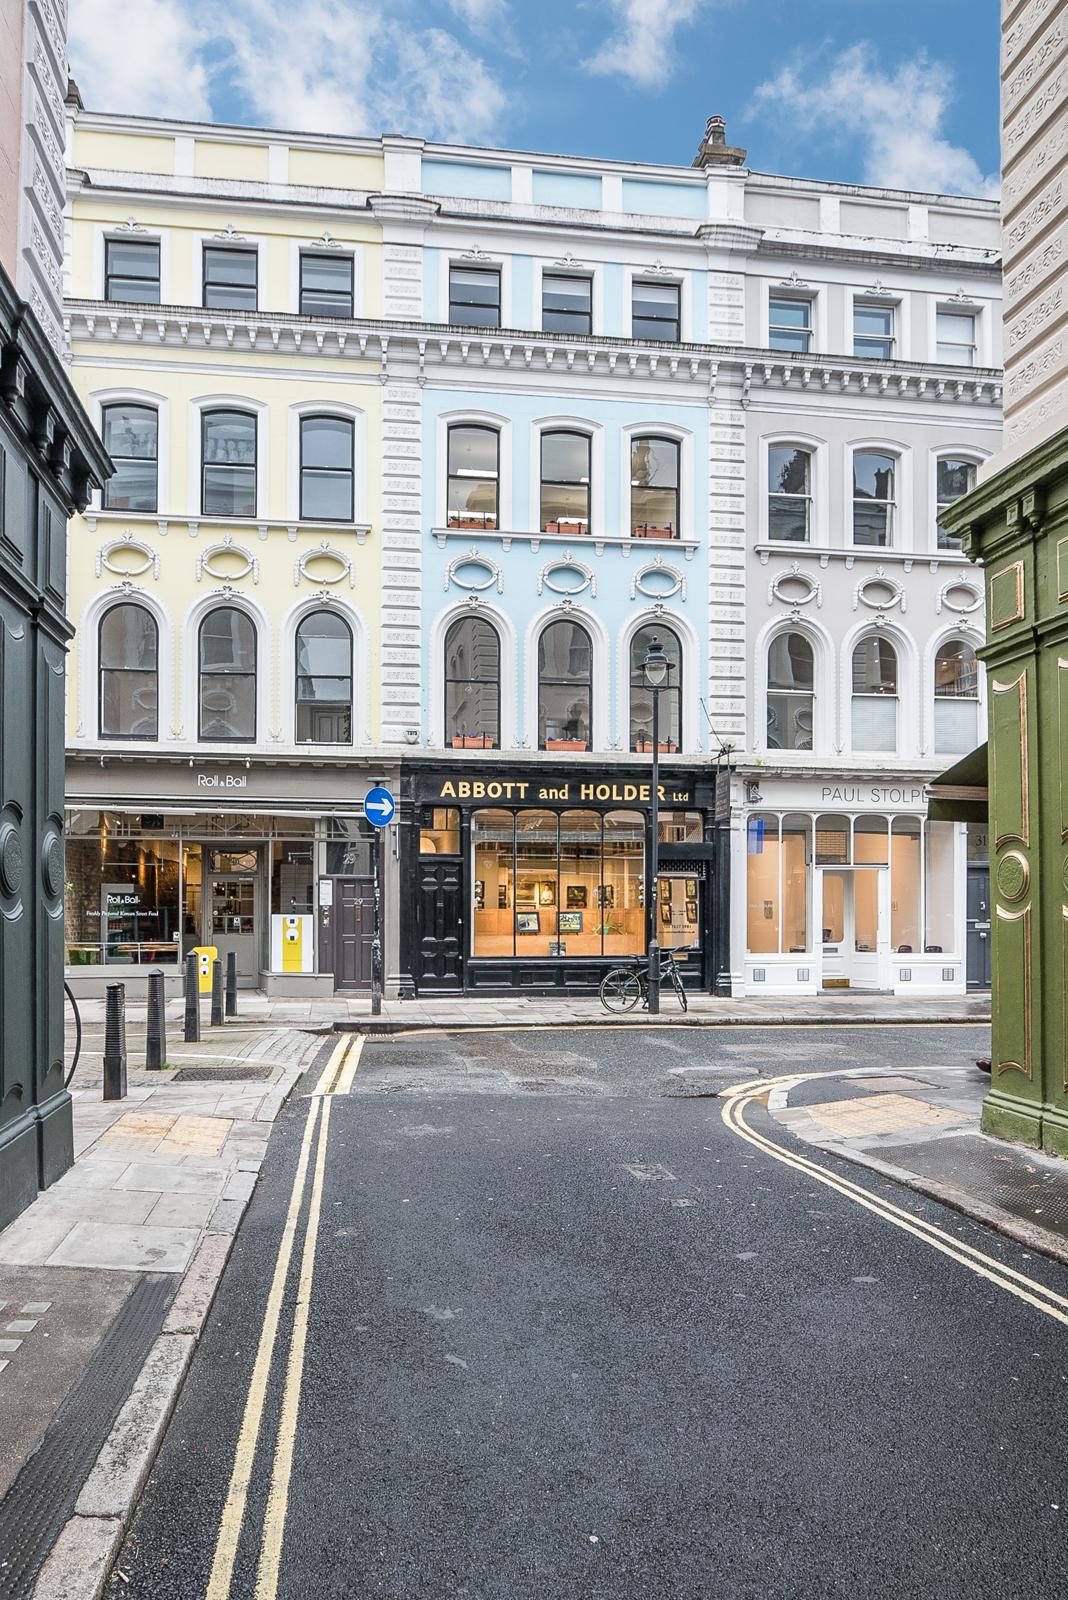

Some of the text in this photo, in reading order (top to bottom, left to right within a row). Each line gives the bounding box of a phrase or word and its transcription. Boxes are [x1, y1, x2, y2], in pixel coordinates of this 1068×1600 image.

[198, 775, 219, 787] Roll
[226, 775, 247, 788] Ball
[440, 781, 690, 802] ABBOTT and HOLDER Ltd
[822, 787, 864, 803] PAUL
[975, 834, 986, 847] 31
[107, 895, 121, 904] Roll
[354, 897, 364, 906] 29
